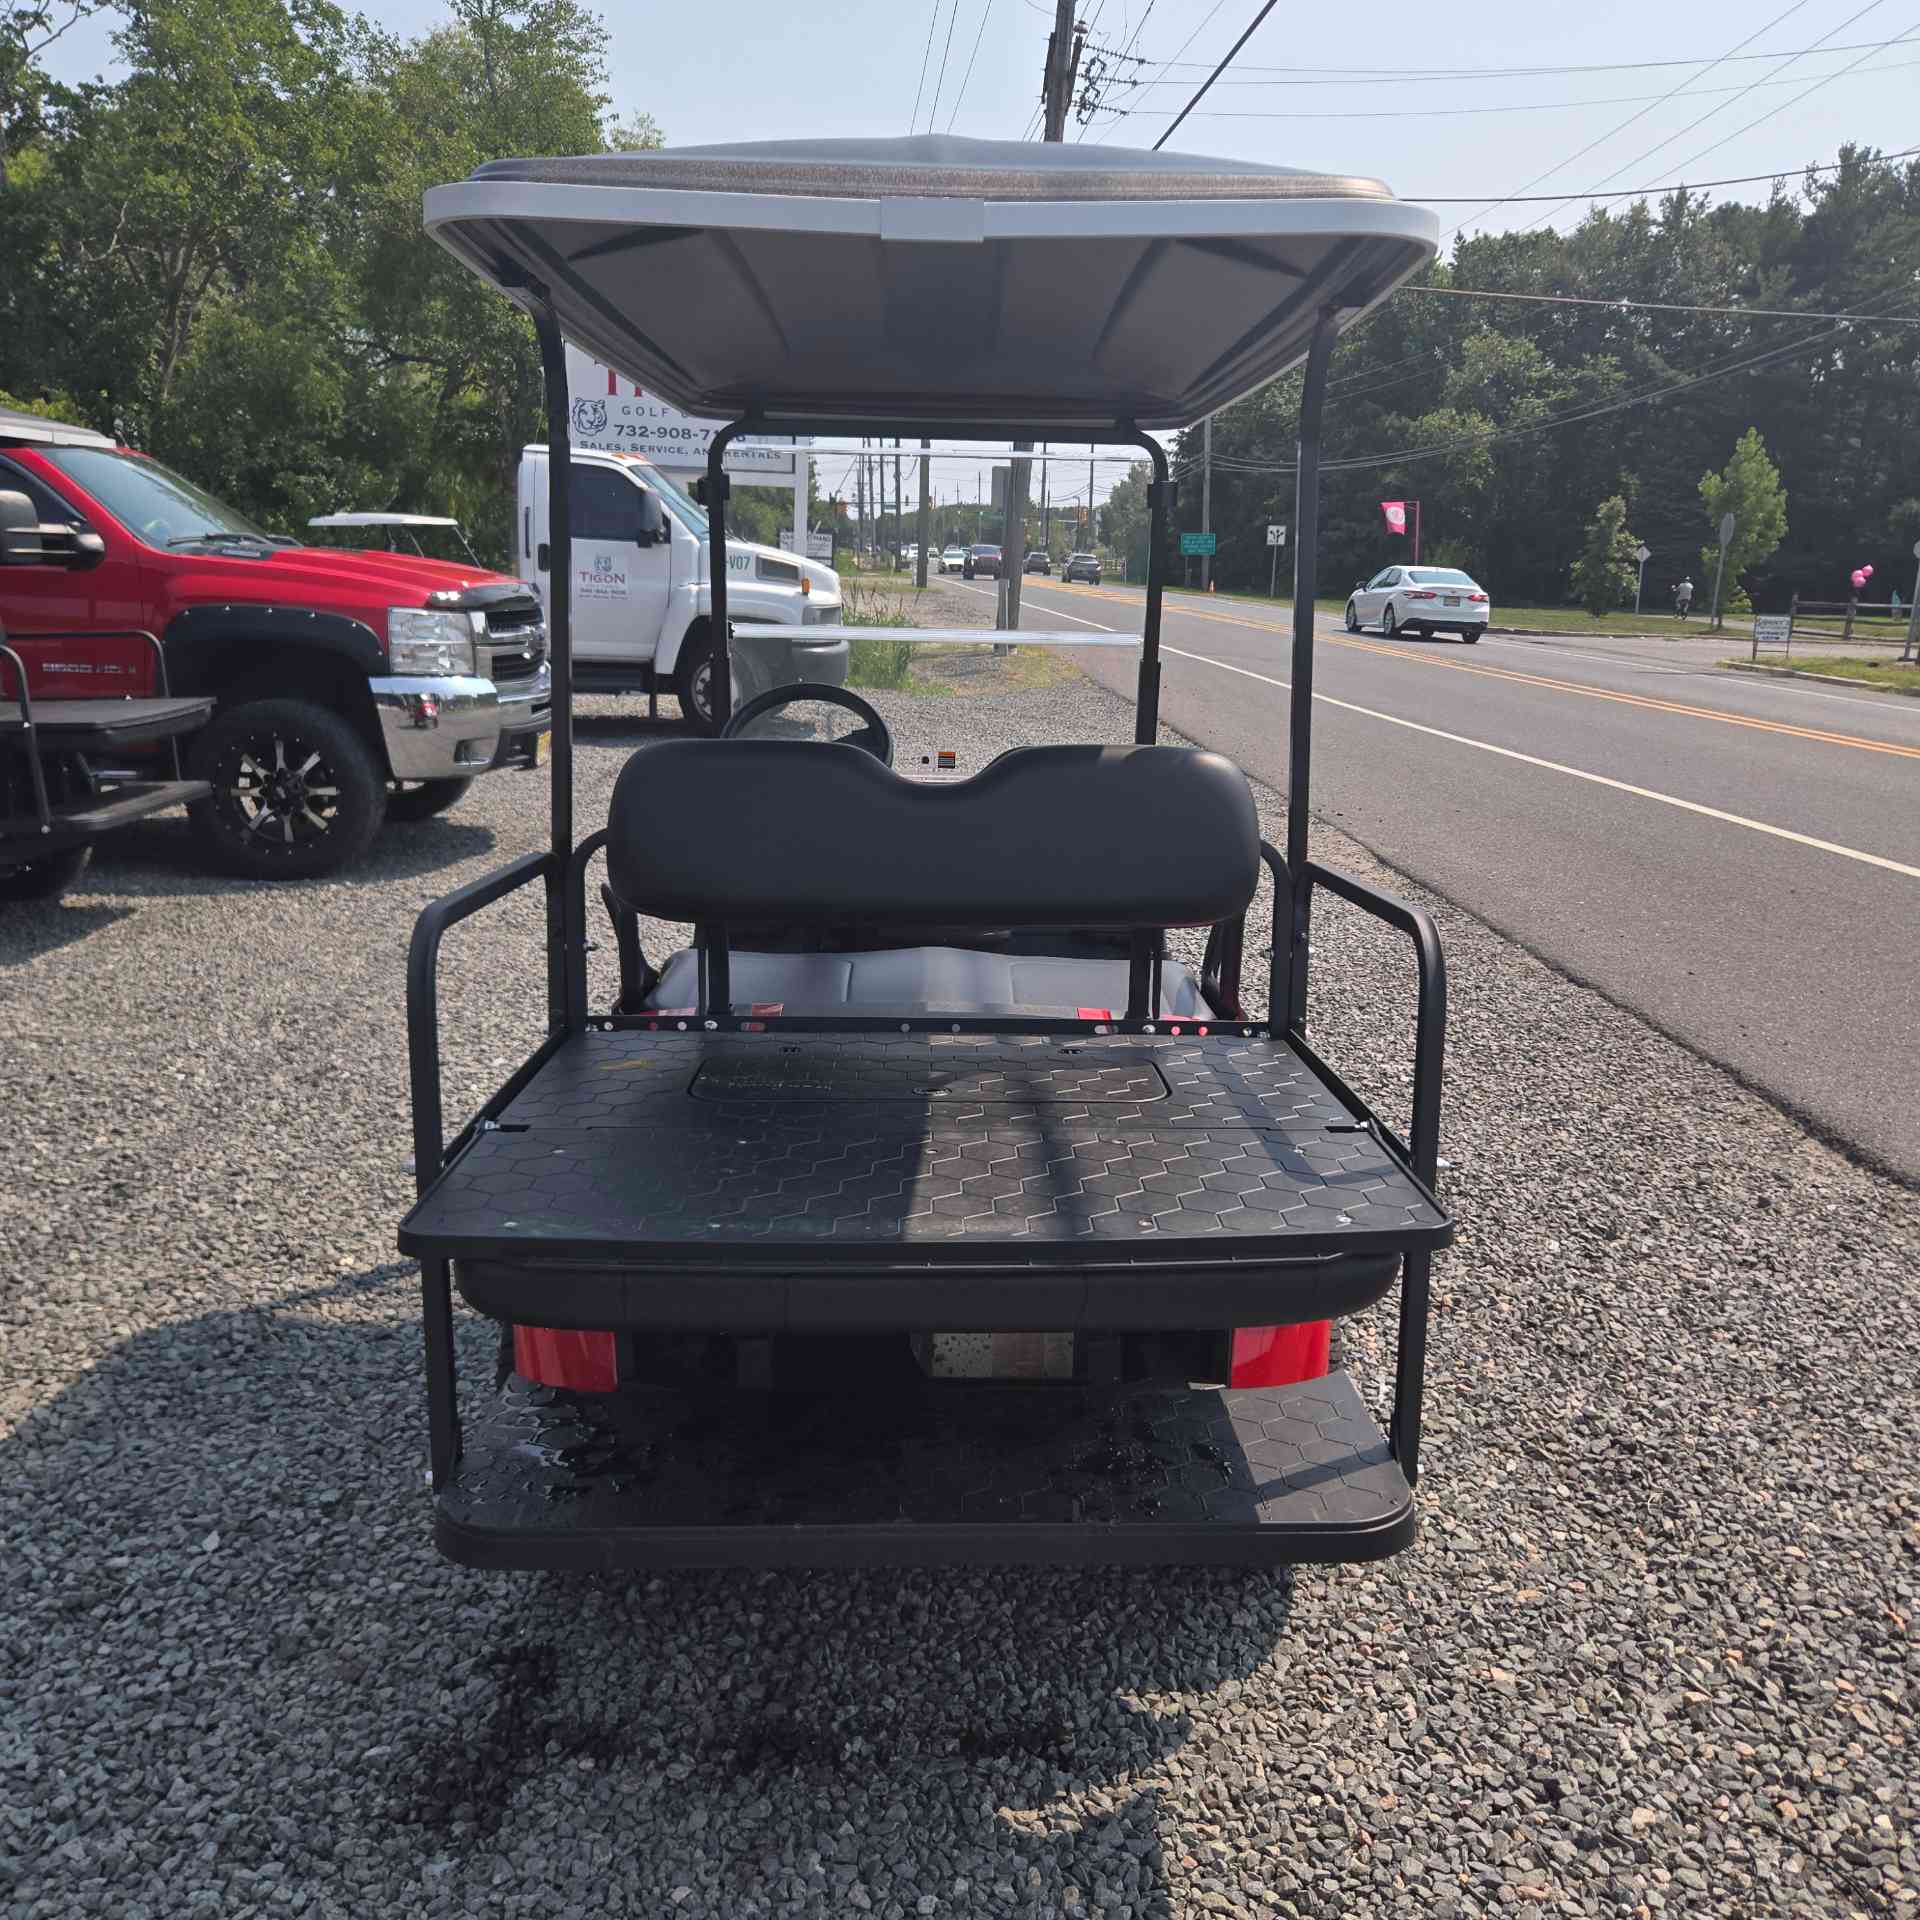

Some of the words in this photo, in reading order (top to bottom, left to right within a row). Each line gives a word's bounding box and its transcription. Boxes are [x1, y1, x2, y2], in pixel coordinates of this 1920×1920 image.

[621, 406, 671, 418] GOLF
[613, 424, 746, 442] 732-908-7
[693, 447, 710, 456] AN
